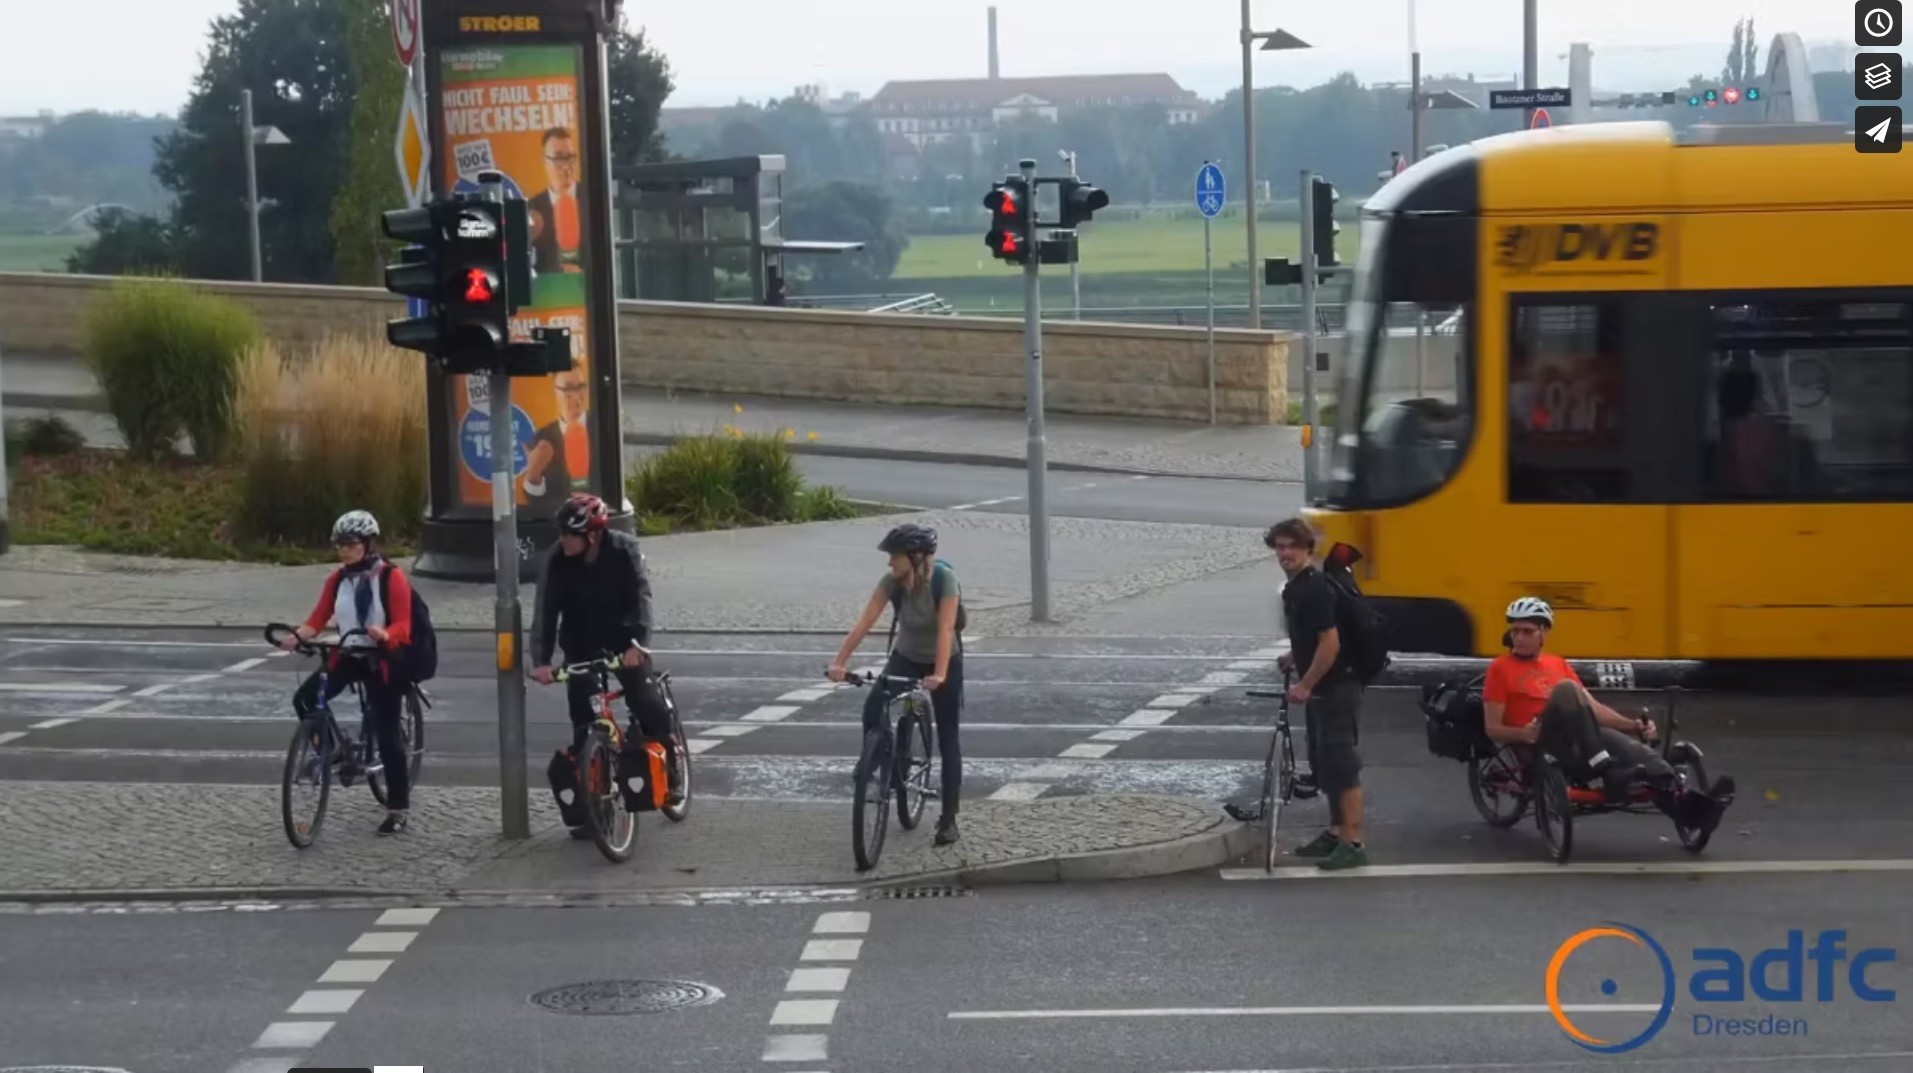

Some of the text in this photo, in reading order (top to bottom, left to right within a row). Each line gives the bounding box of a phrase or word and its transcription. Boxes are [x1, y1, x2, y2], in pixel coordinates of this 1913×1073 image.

[442, 88, 484, 108] NICHT
[489, 86, 532, 104] FAUL
[1495, 92, 1565, 105] Bautzner Straße
[445, 104, 573, 136] WECHSELN!
[1555, 223, 1659, 261] DVB
